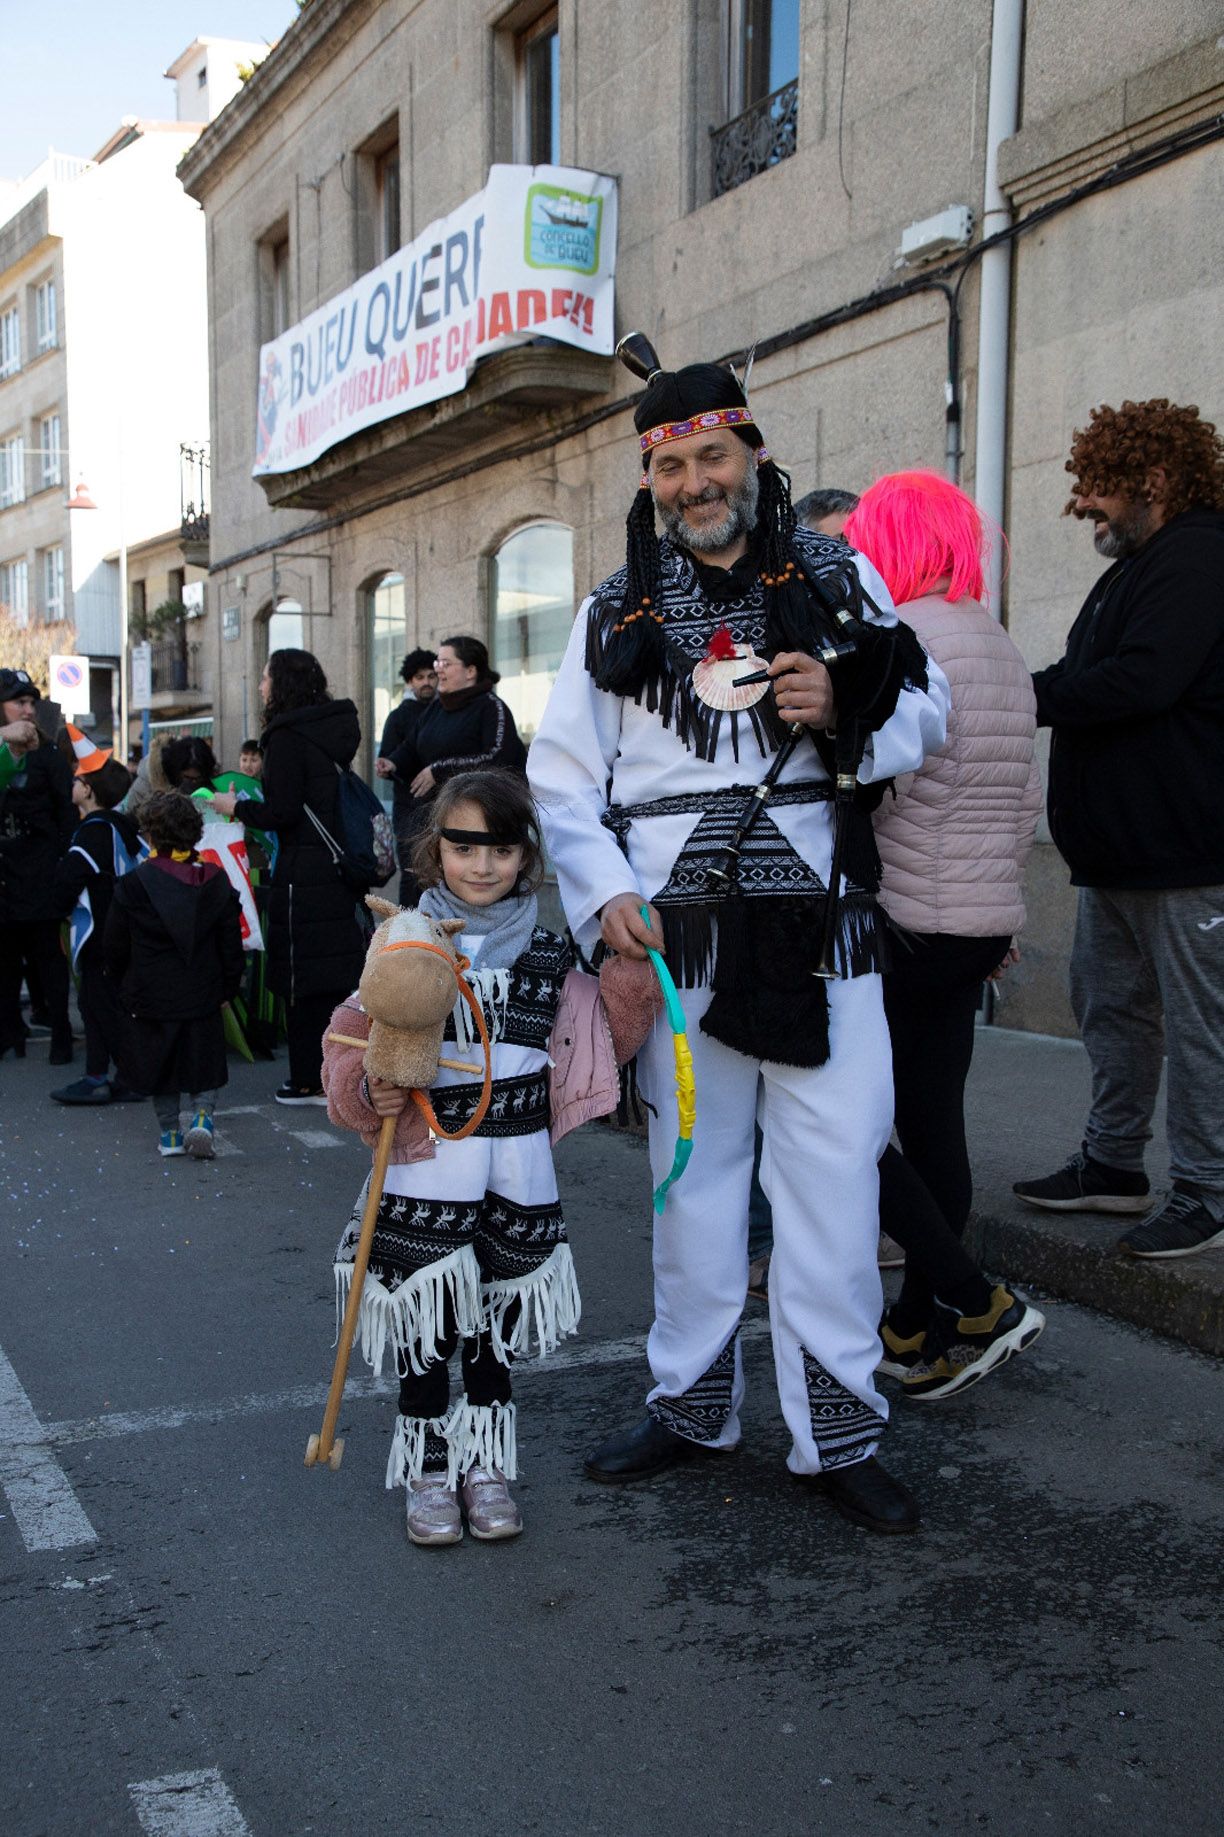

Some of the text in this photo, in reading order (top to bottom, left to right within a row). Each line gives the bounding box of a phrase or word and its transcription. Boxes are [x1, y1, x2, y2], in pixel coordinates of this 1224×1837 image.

[540, 230, 590, 248] CONCELLO
[290, 298, 359, 409] BUEU
[414, 335, 441, 386] DE
